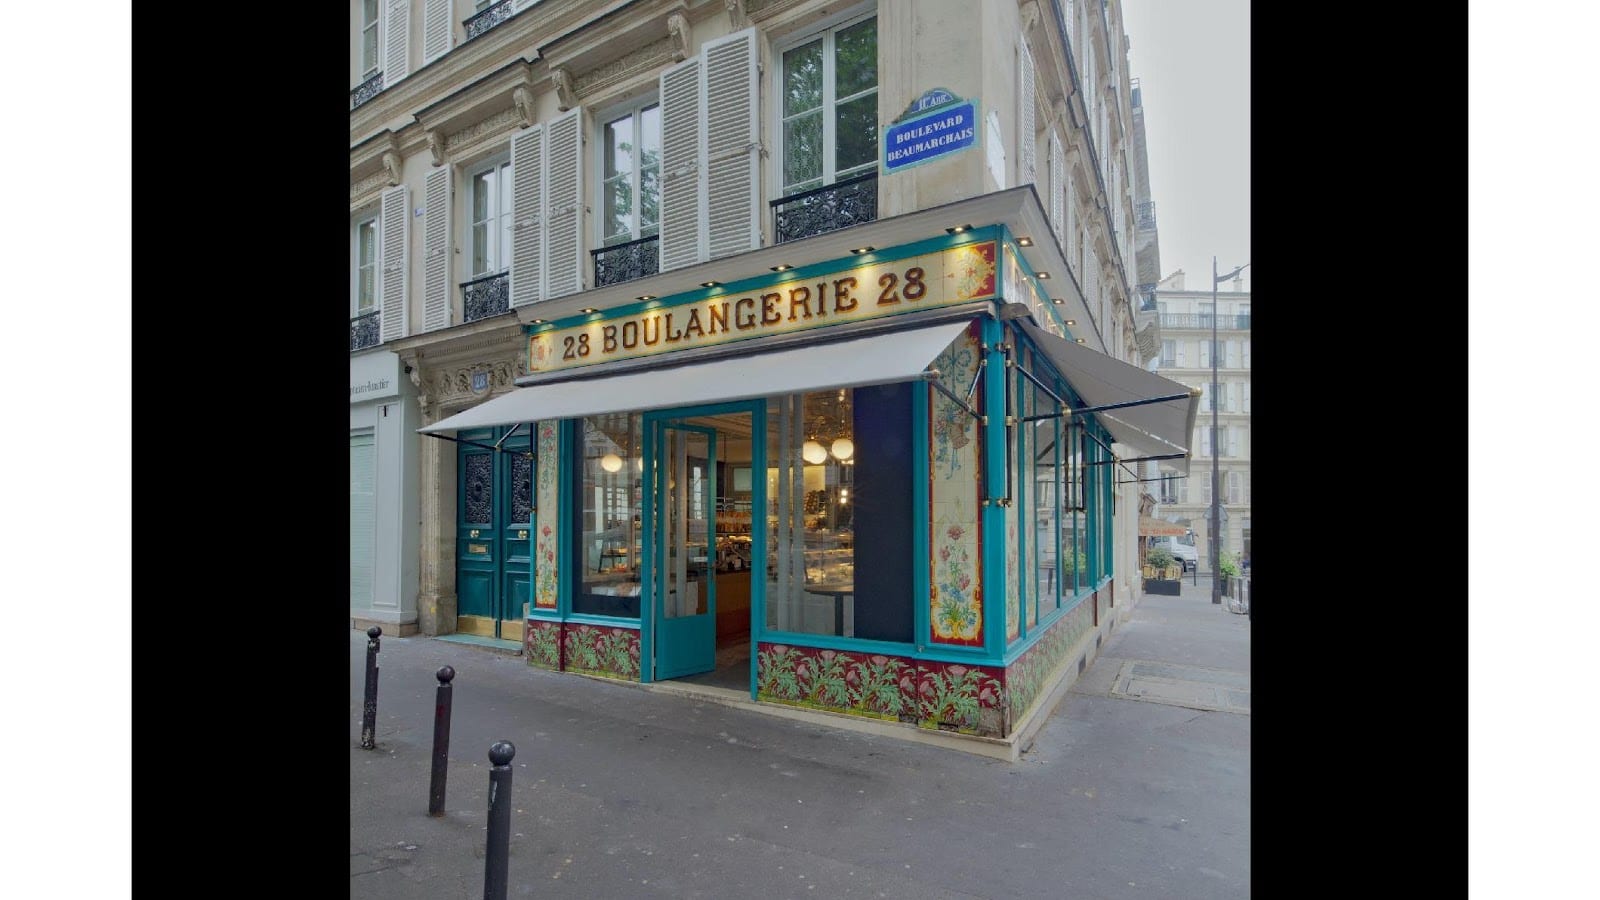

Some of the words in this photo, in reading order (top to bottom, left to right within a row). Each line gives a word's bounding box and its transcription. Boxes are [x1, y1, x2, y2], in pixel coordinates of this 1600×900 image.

[888, 128, 973, 161] BEAUMARCHAIS
[896, 115, 963, 144] BOULEVARD
[563, 333, 590, 361] 28
[602, 276, 858, 353] BOULANGERIE
[877, 266, 927, 307] 28
[474, 375, 486, 388] 28
